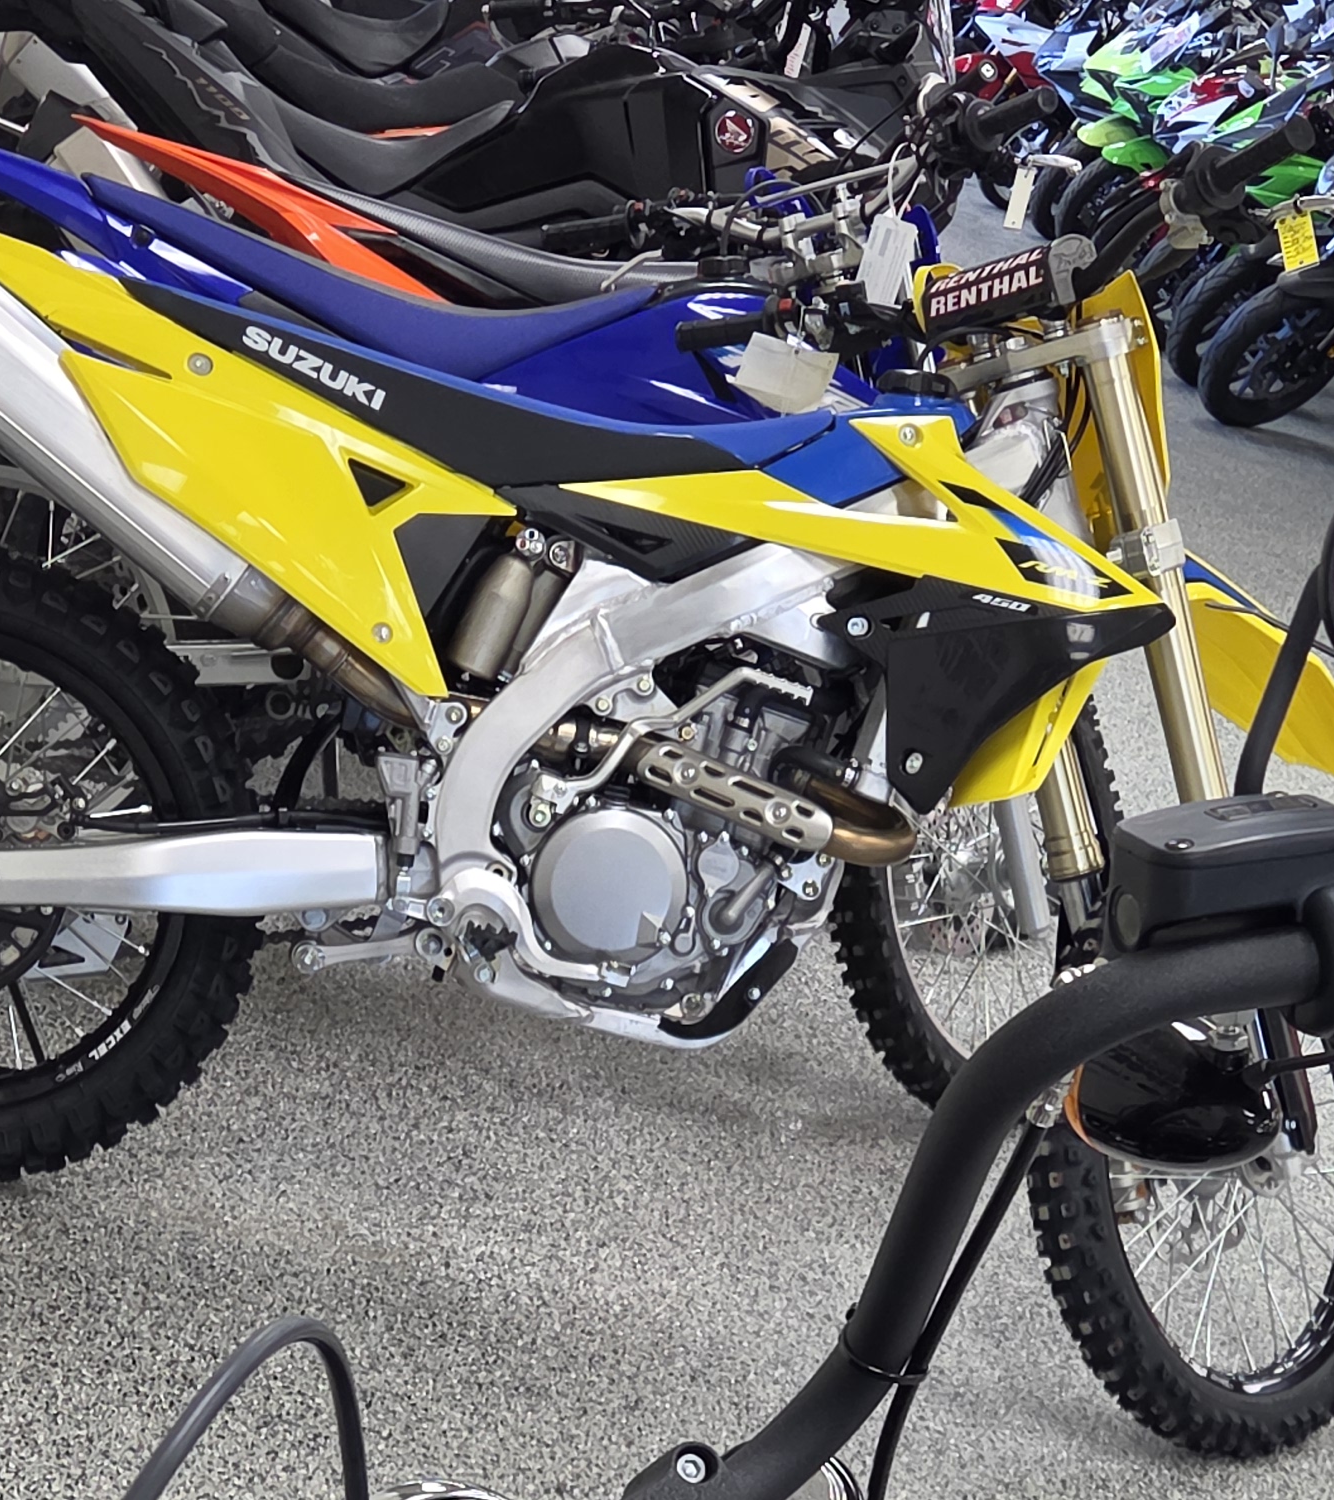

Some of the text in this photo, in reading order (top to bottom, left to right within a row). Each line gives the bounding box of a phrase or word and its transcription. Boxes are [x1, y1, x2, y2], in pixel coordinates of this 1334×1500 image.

[195, 76, 251, 120] 1100
[929, 246, 1044, 294] RENTHAL
[929, 265, 1043, 318] RENTHAL
[242, 325, 387, 411] SUZUKI
[971, 592, 1032, 613] 450
[88, 1018, 132, 1060] EXCEL
